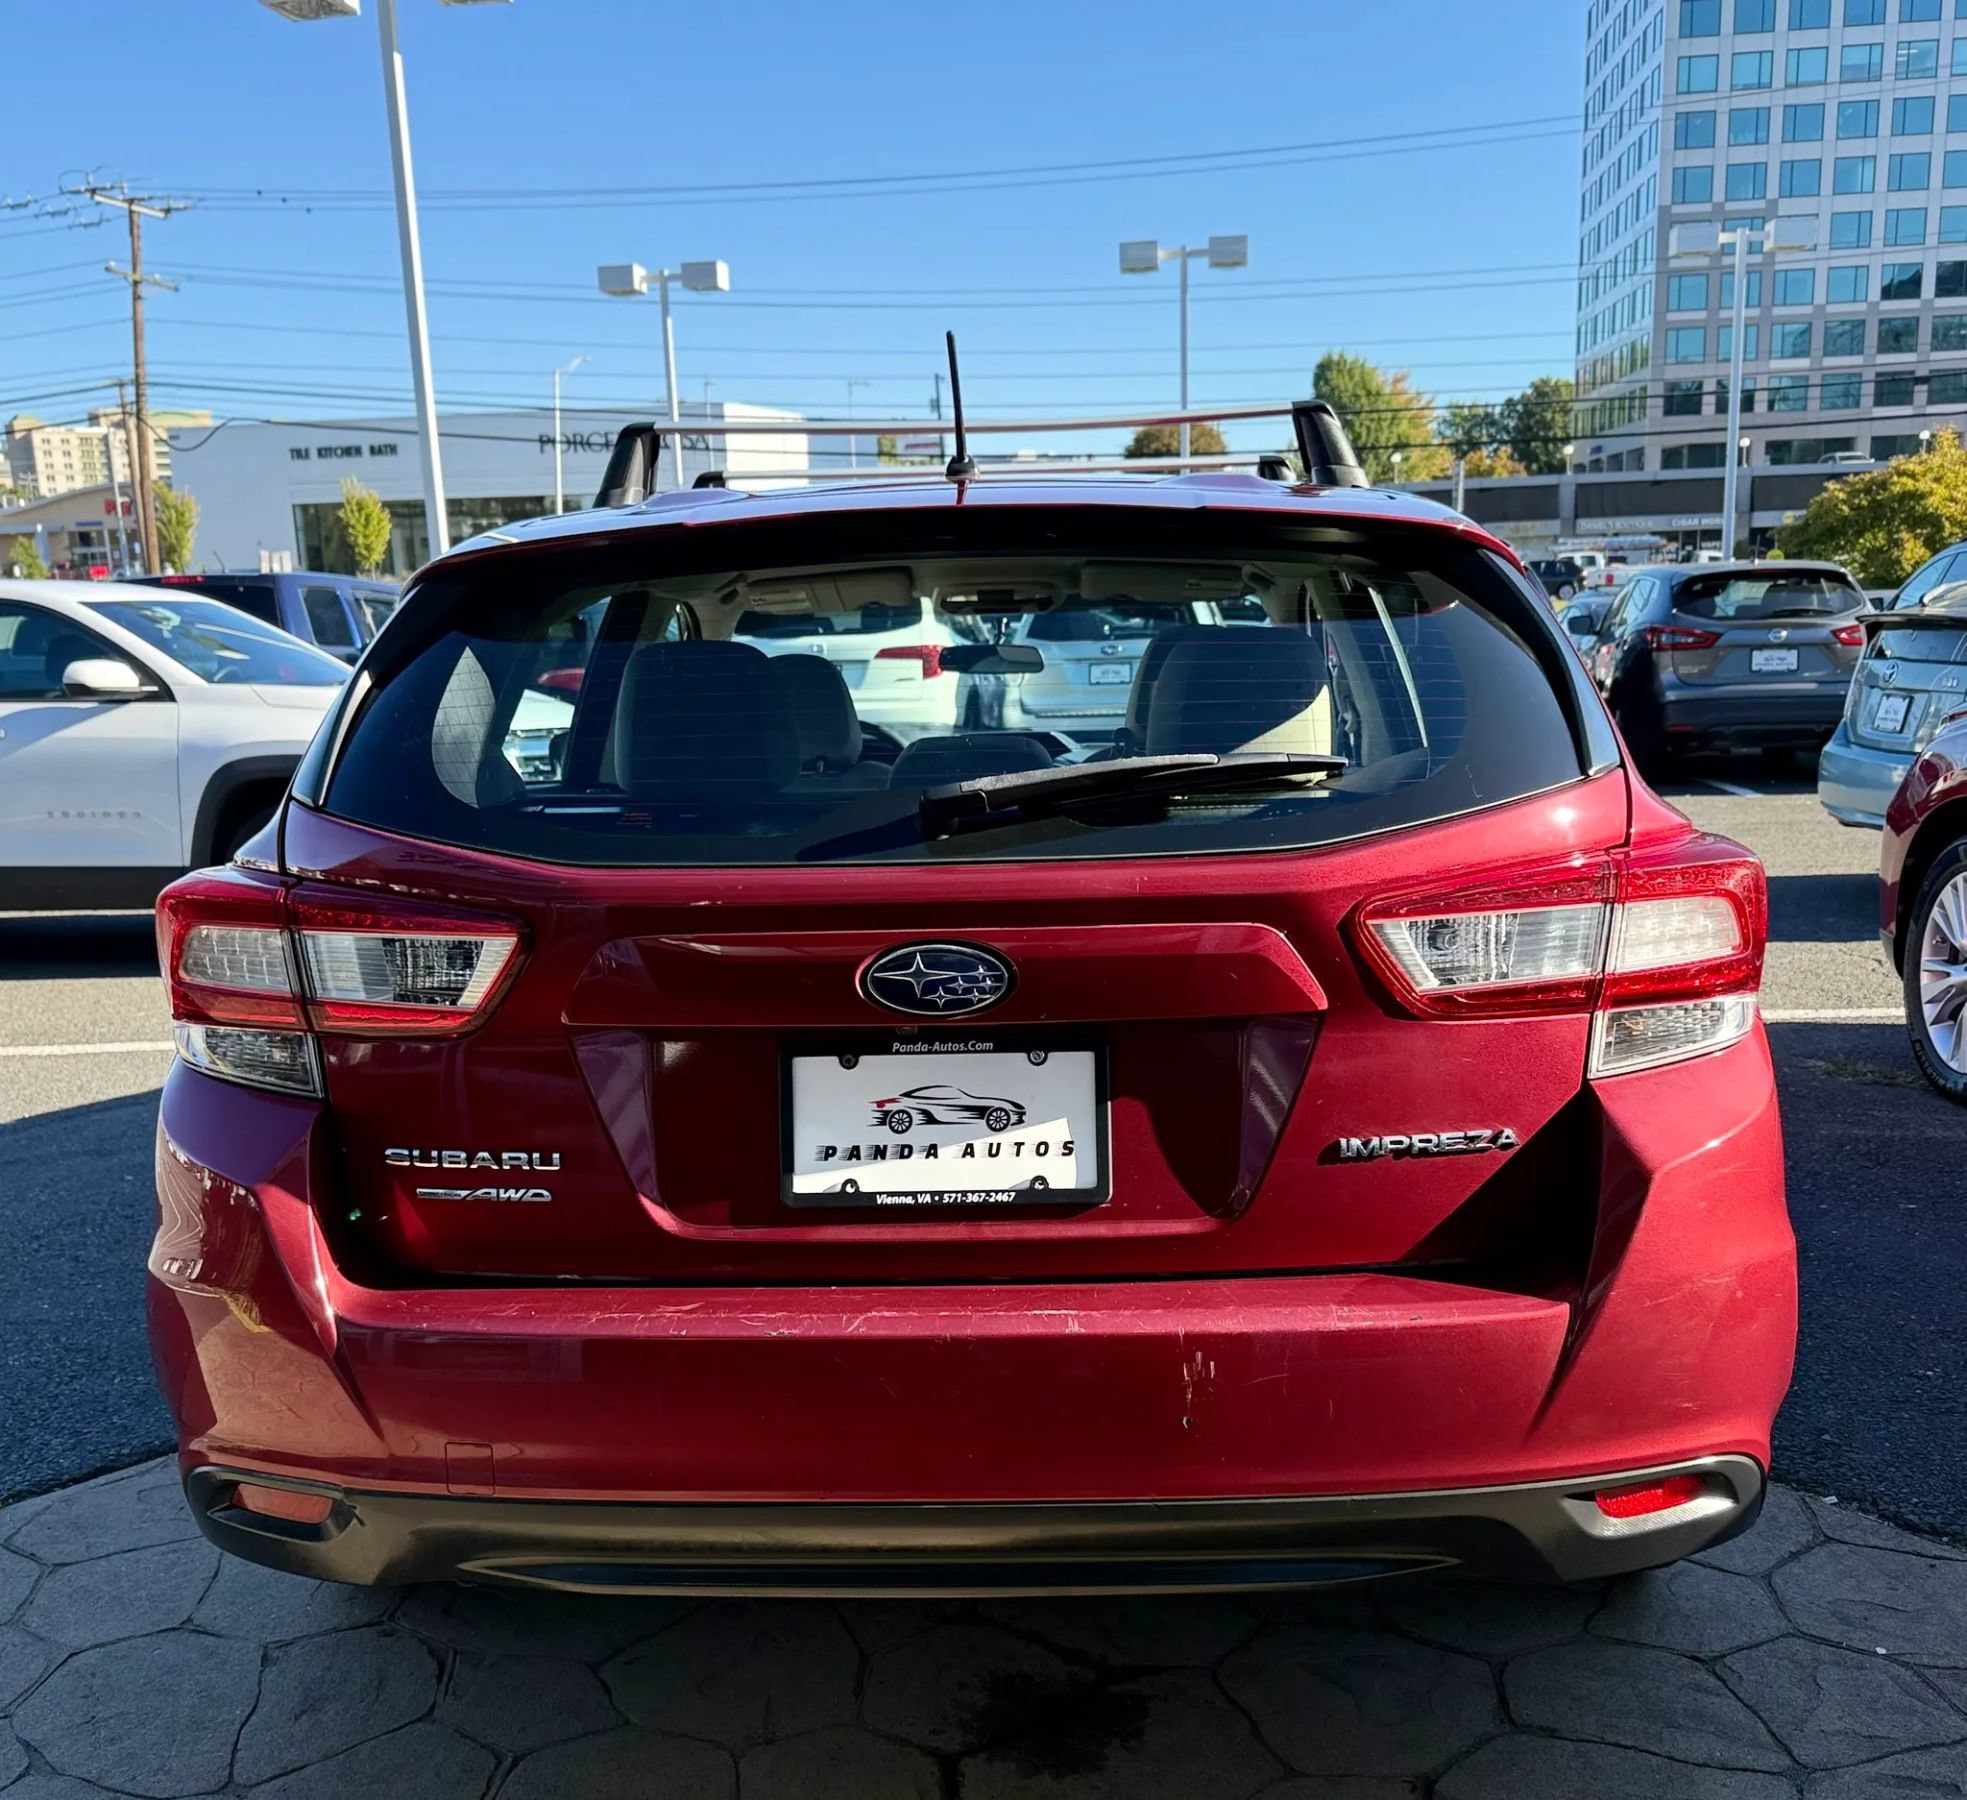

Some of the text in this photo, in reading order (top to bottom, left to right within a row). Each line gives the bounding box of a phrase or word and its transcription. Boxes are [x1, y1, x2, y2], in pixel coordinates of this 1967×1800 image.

[289, 444, 398, 460] TILE KITCHEN BATH
[1671, 518, 1699, 528] CIGAR
[892, 1040, 994, 1053] Panda-Autos.Com
[1339, 1128, 1520, 1158] IMPREZA
[814, 1140, 1075, 1162] PANDA AUTOS
[384, 1148, 560, 1171] SUBARU
[466, 1187, 552, 1202] AWD
[876, 1191, 1016, 1206] Vienna, VA 571-367-2467
